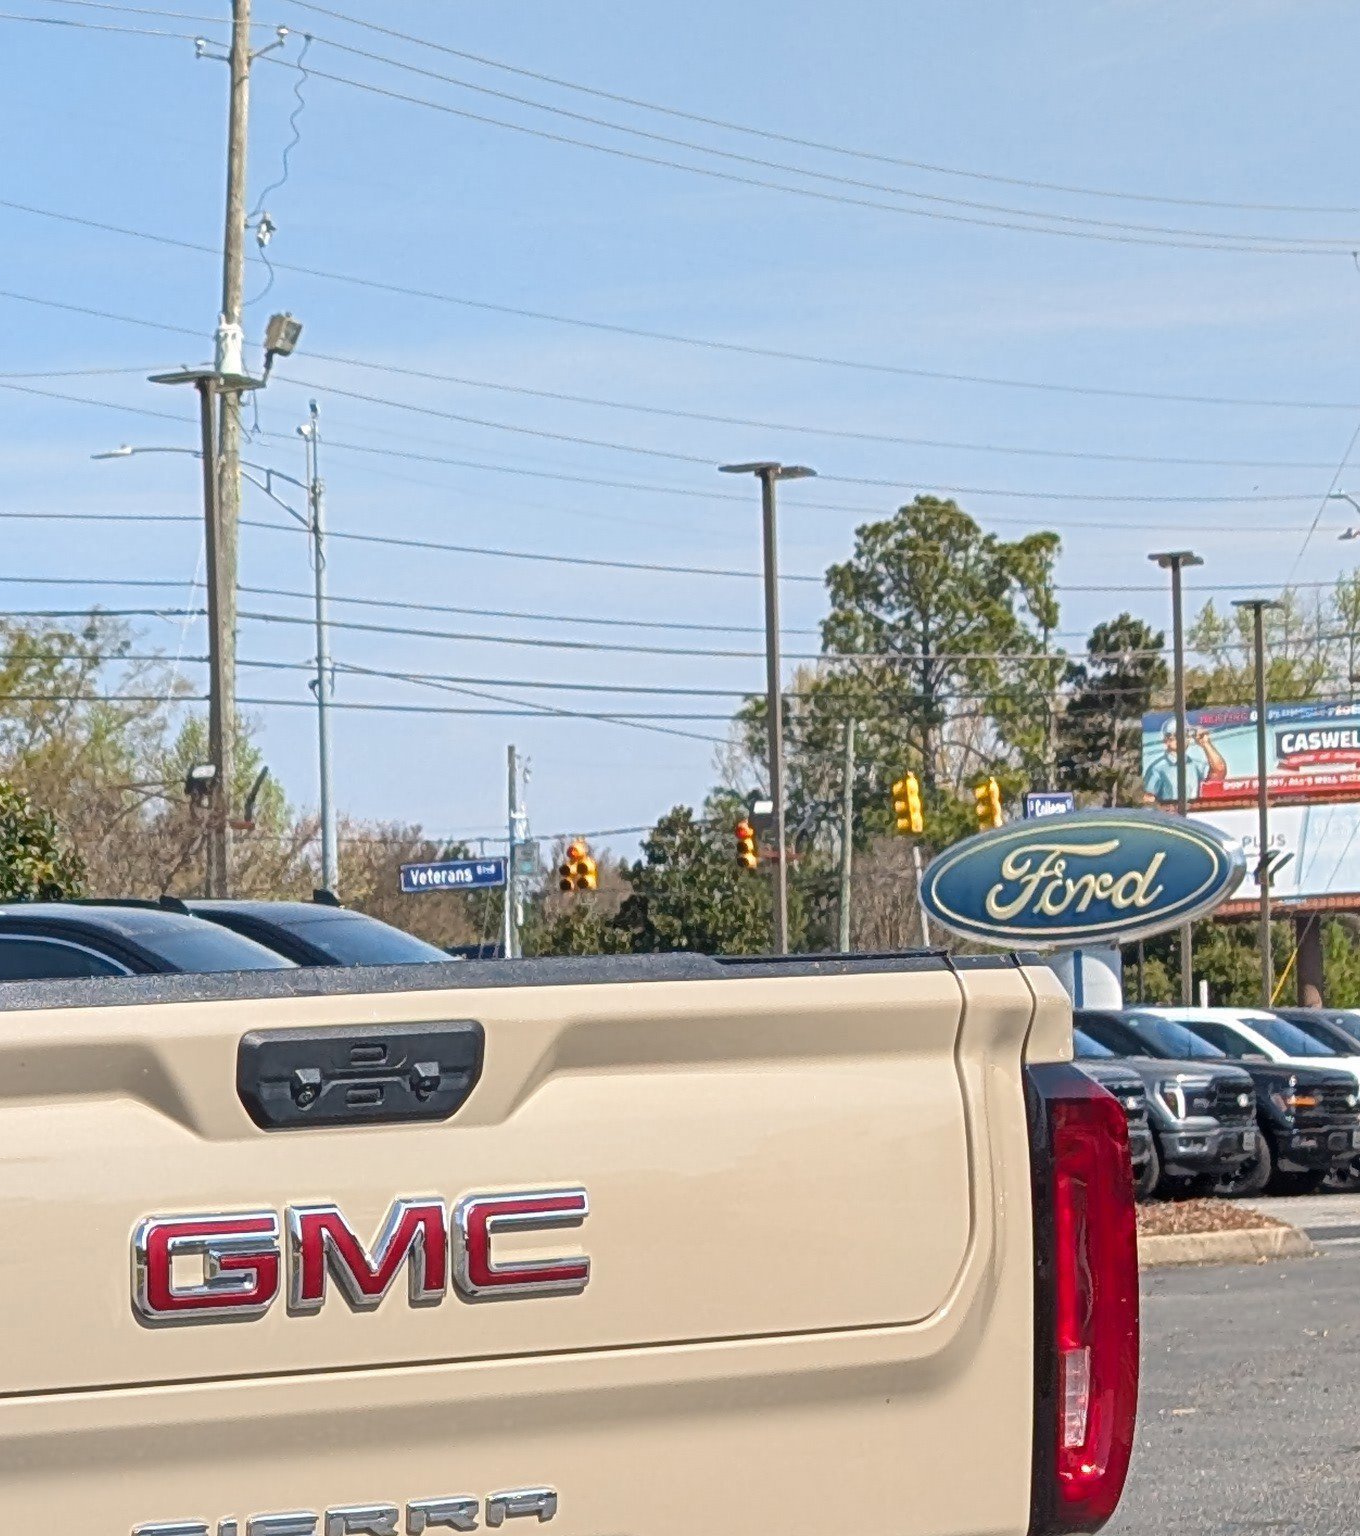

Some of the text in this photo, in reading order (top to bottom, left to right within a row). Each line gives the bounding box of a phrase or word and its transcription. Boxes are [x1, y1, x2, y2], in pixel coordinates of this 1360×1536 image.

[410, 866, 473, 885] Veterans
[985, 839, 1167, 920] Ford
[132, 1187, 590, 1322] GMC
